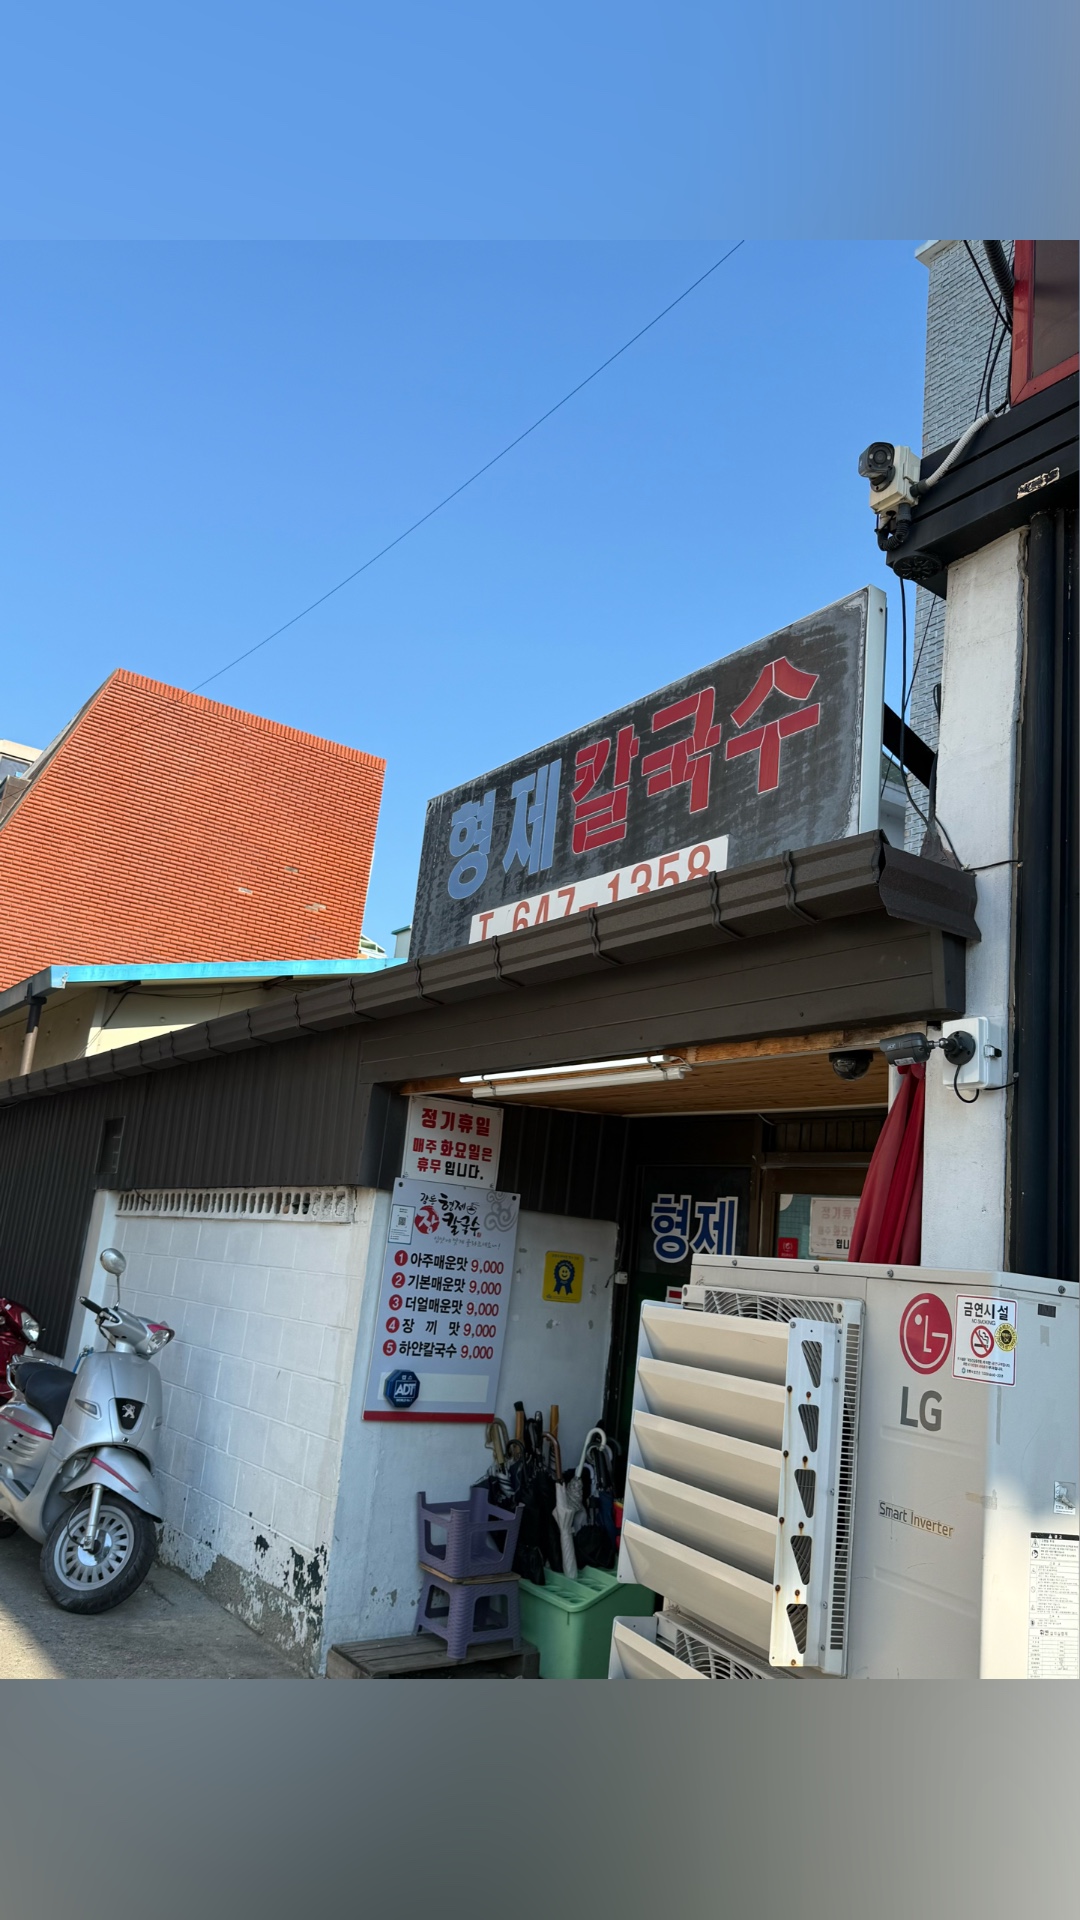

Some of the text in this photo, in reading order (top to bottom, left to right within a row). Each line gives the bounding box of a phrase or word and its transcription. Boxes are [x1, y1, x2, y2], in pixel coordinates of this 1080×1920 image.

[421, 1108, 491, 1137] 정기휴일
[412, 1137, 493, 1162] 매주 화요일은
[417, 1157, 484, 1180] 휴무 입니다.
[416, 1207, 439, 1234] 장
[442, 1212, 480, 1237] 칼국수
[651, 1194, 738, 1264] 형제
[410, 1252, 468, 1272] 아주매운맛
[470, 1259, 505, 1275] 9,000
[407, 1274, 466, 1293] 기본매운맛
[468, 1280, 502, 1295] 9,000
[466, 1302, 499, 1317] 9,000
[964, 1302, 1008, 1321] 금연시설
[463, 1323, 497, 1338] 9,000
[398, 1340, 457, 1359] 하얀칼국수
[460, 1345, 494, 1360] 9,000
[394, 1383, 417, 1396] ADT
[900, 1386, 943, 1432] LG
[879, 1502, 954, 1537] Smart Inverter
